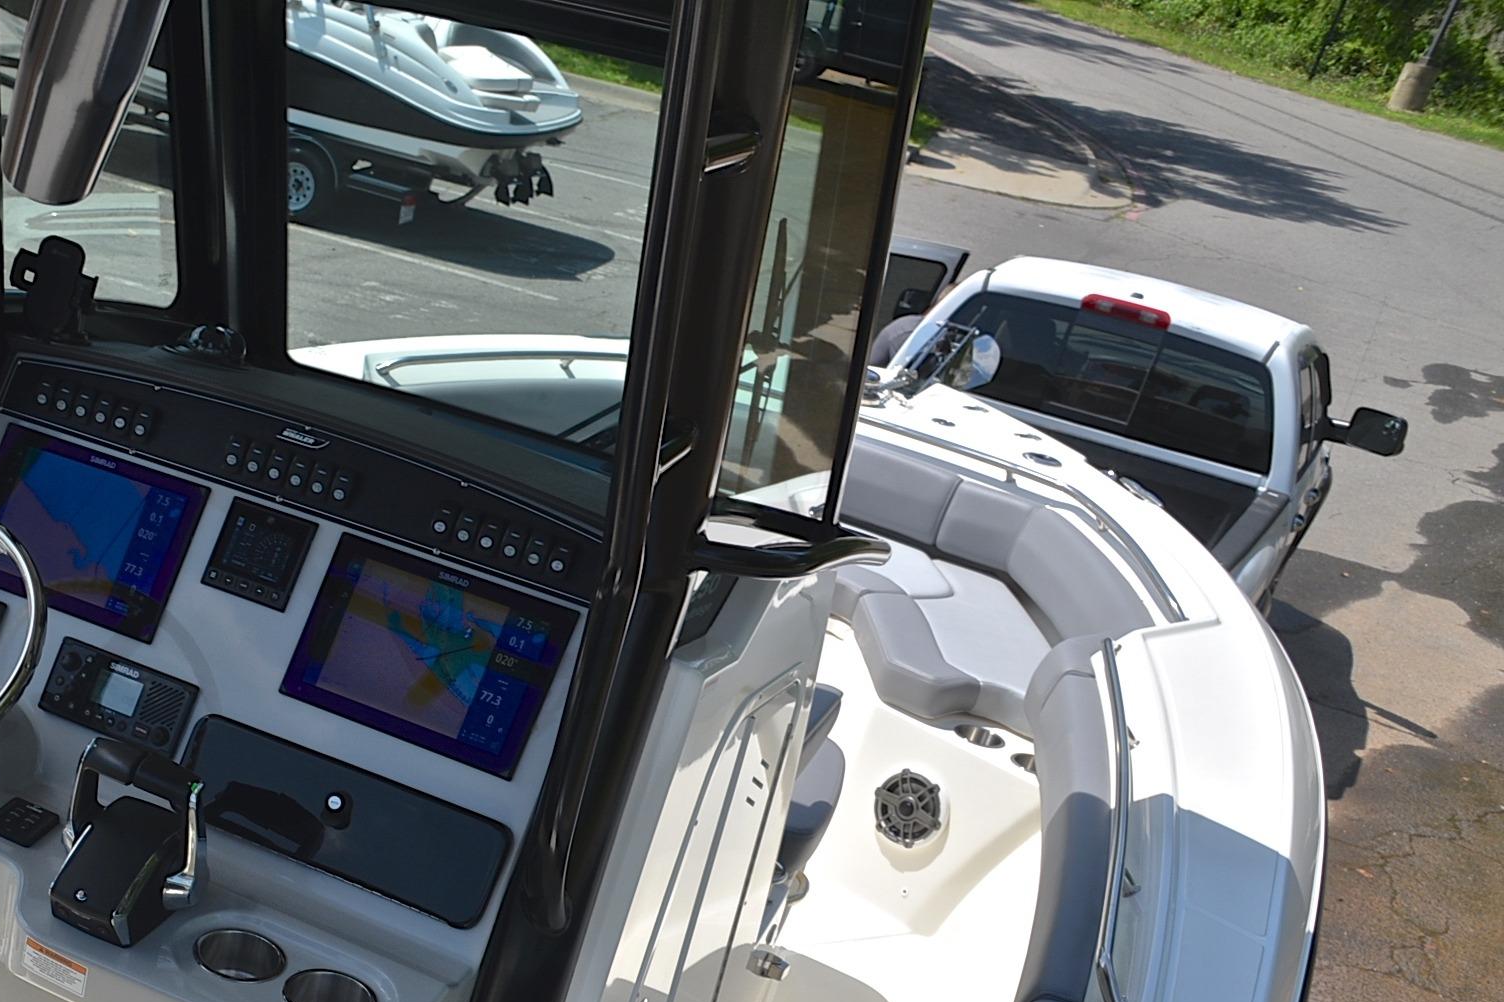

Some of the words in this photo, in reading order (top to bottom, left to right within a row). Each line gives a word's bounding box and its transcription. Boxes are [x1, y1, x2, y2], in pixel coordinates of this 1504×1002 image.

[90, 455, 117, 469] SIMRAD
[439, 571, 470, 588] SIMRAD
[517, 617, 533, 631] 7.5
[508, 636, 525, 650] 0.1
[110, 661, 140, 679] SIMRAD
[480, 690, 502, 706] 77.3
[486, 714, 494, 725] 0
